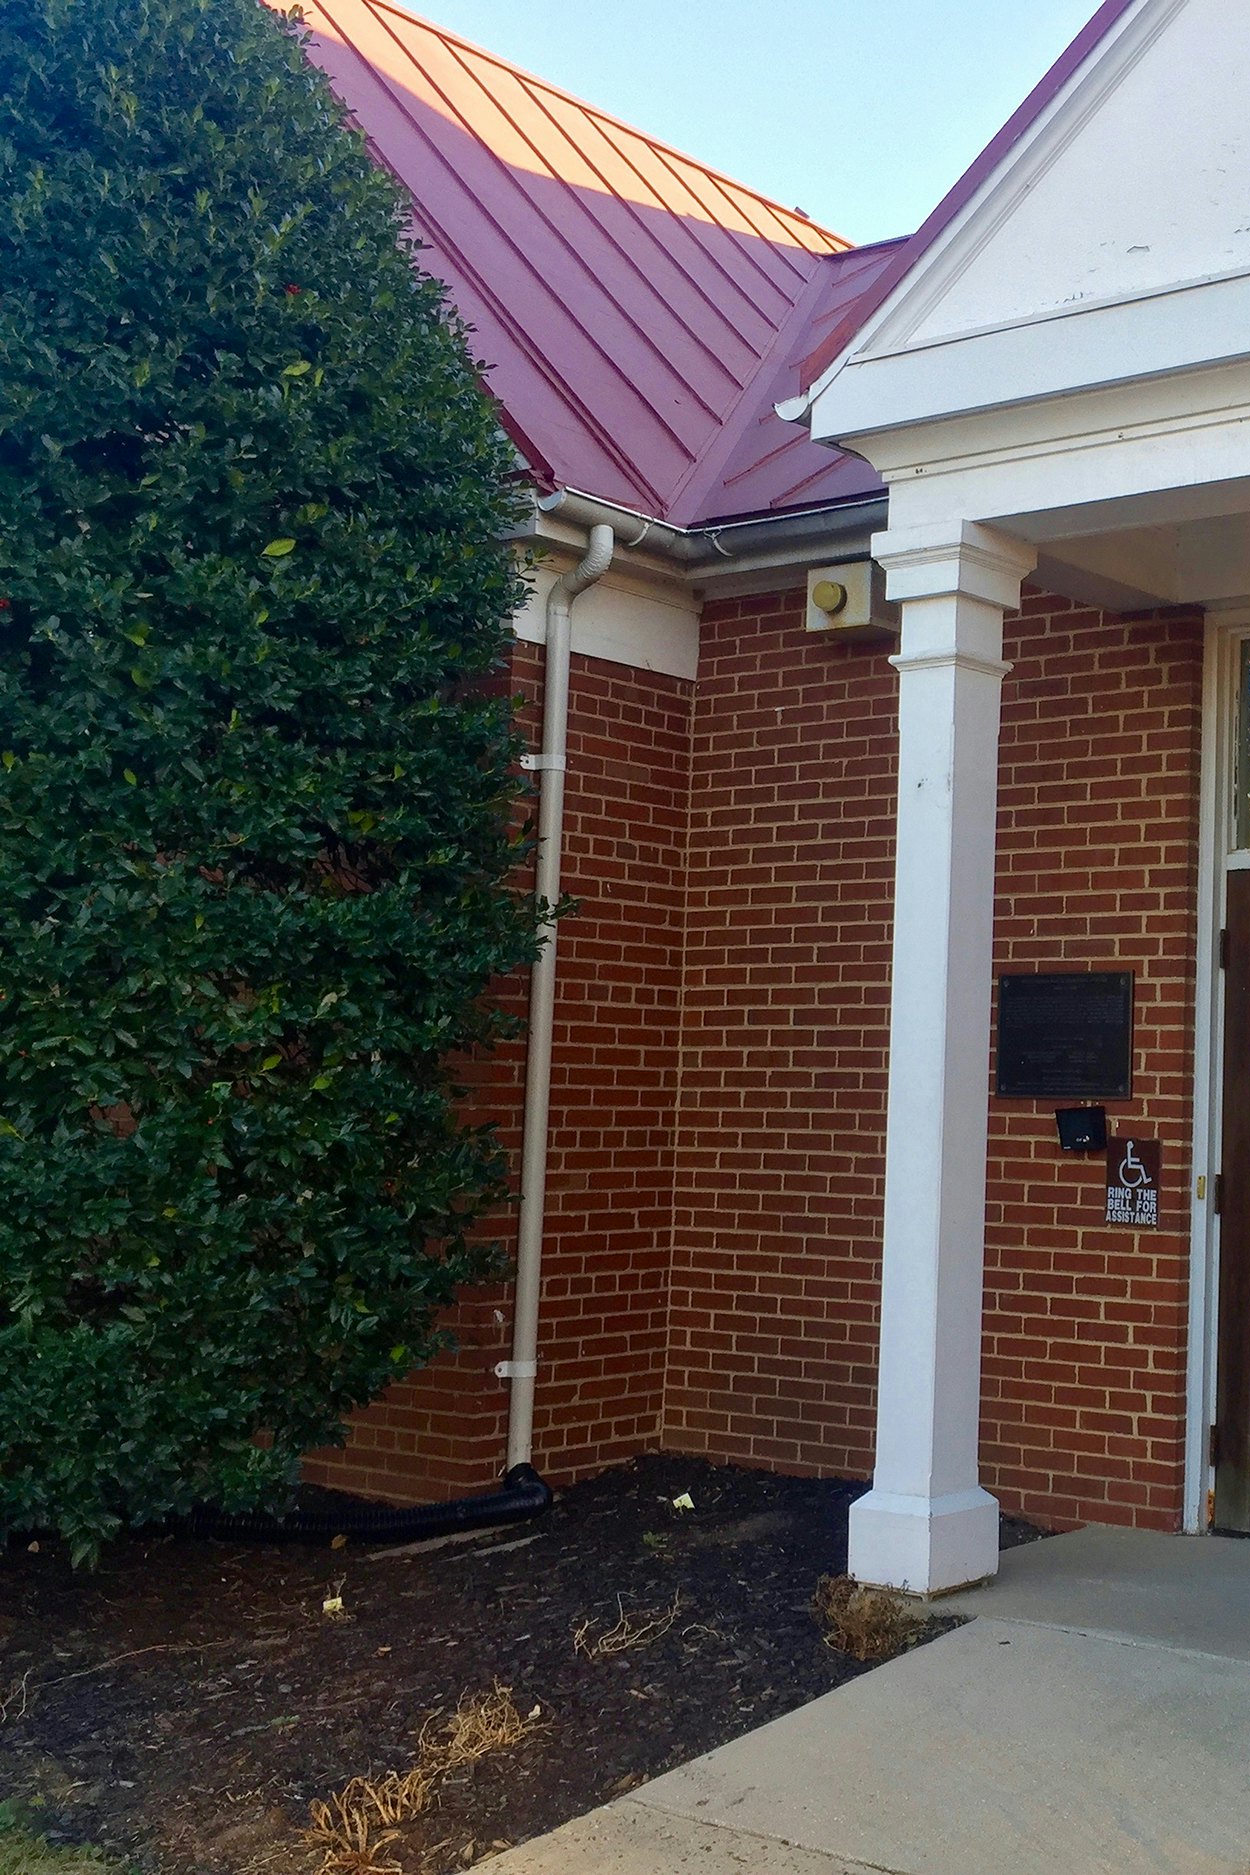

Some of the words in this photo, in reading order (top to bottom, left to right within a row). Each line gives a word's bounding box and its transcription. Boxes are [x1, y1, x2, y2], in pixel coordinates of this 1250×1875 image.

[1107, 1186, 1132, 1199] RING
[1136, 1189, 1157, 1201] THE
[1107, 1198, 1132, 1211] BELL
[1136, 1200, 1157, 1213] FOR
[1105, 1210, 1157, 1225] ASSISTANCE
